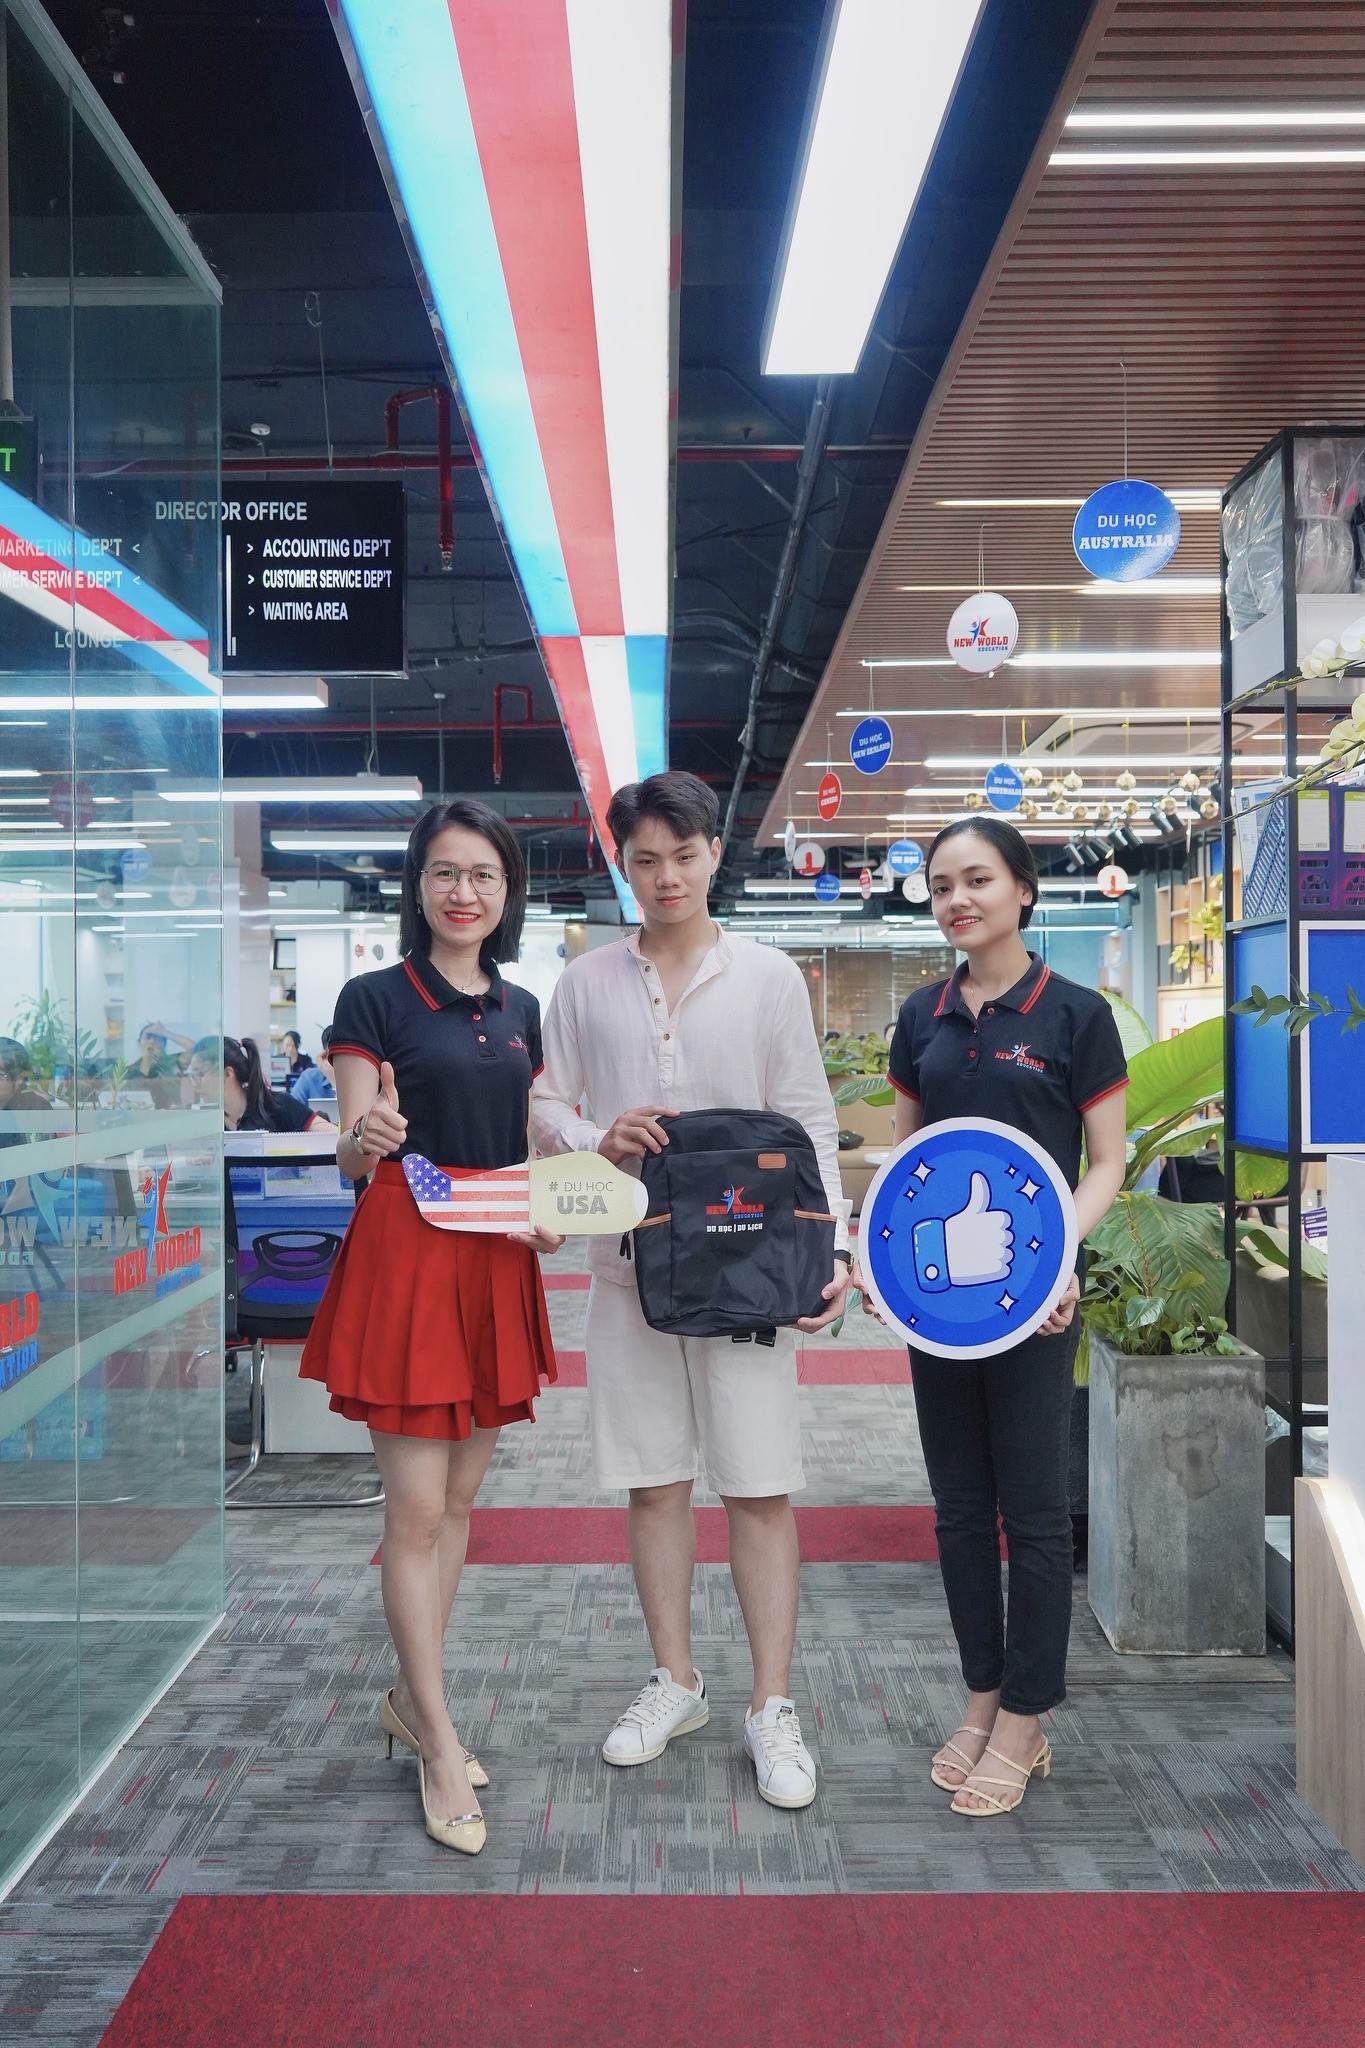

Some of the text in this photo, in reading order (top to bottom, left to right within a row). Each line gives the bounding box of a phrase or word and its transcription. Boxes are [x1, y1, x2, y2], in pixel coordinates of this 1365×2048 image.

[155, 501, 308, 521] DIRECTOR OFFICE
[1097, 513, 1157, 529] DU HỌC
[263, 539, 392, 558] ACCOUNTING DEP'T
[1079, 534, 1175, 550] AUSTRALIA
[32, 570, 84, 589] SERVICE
[263, 569, 392, 588] CUSTOMER SERVICE DEP'T
[263, 602, 348, 620] WAITING AREA
[55, 631, 123, 649] LOUNGE
[953, 636, 1009, 648] NEW WORLD
[994, 1051, 1045, 1070] NEW WORLD
[564, 1182, 582, 1192] DU
[556, 1195, 609, 1215] USA
[732, 1203, 765, 1214] WORLD
[706, 1222, 764, 1234] DU HỌC DU LỊCH
[113, 1247, 149, 1297] NEW
[154, 1226, 201, 1278] WORLD
